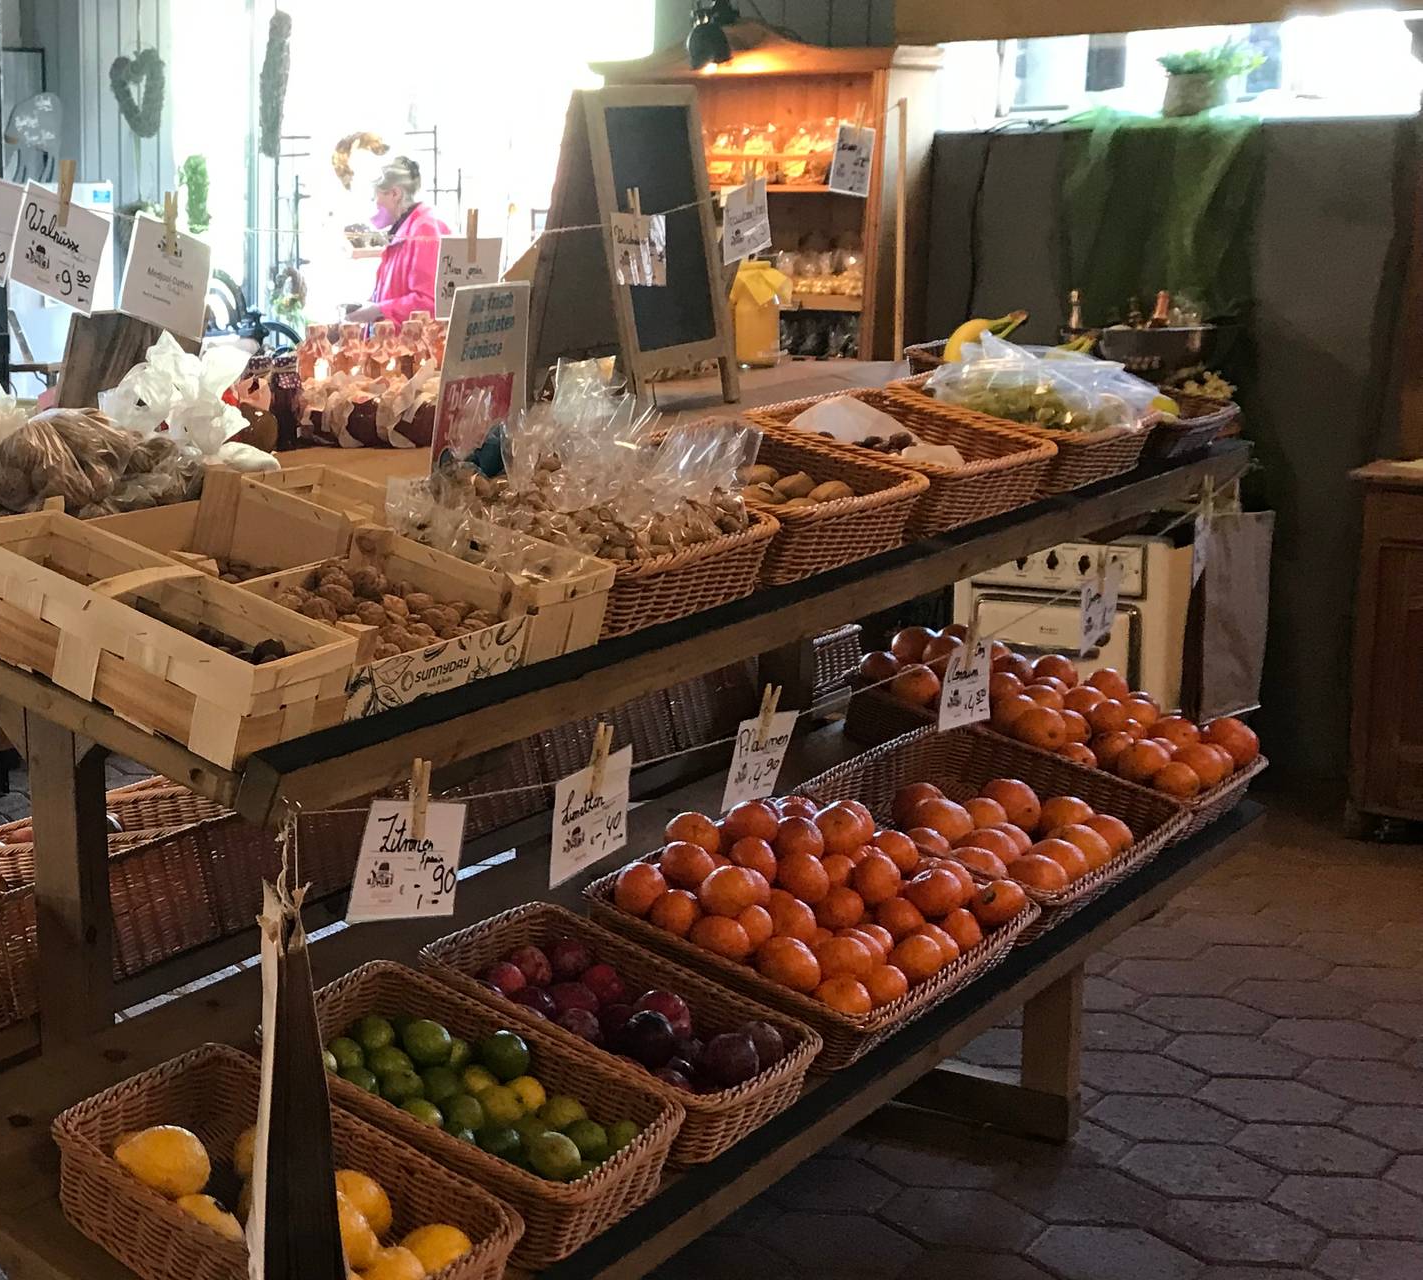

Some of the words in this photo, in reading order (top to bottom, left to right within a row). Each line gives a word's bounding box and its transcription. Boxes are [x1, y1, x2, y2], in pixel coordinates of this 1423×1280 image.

[25, 202, 80, 253] Walnüsse
[414, 656, 471, 683] SUNNYDAY
[378, 812, 434, 852] Zitronen
